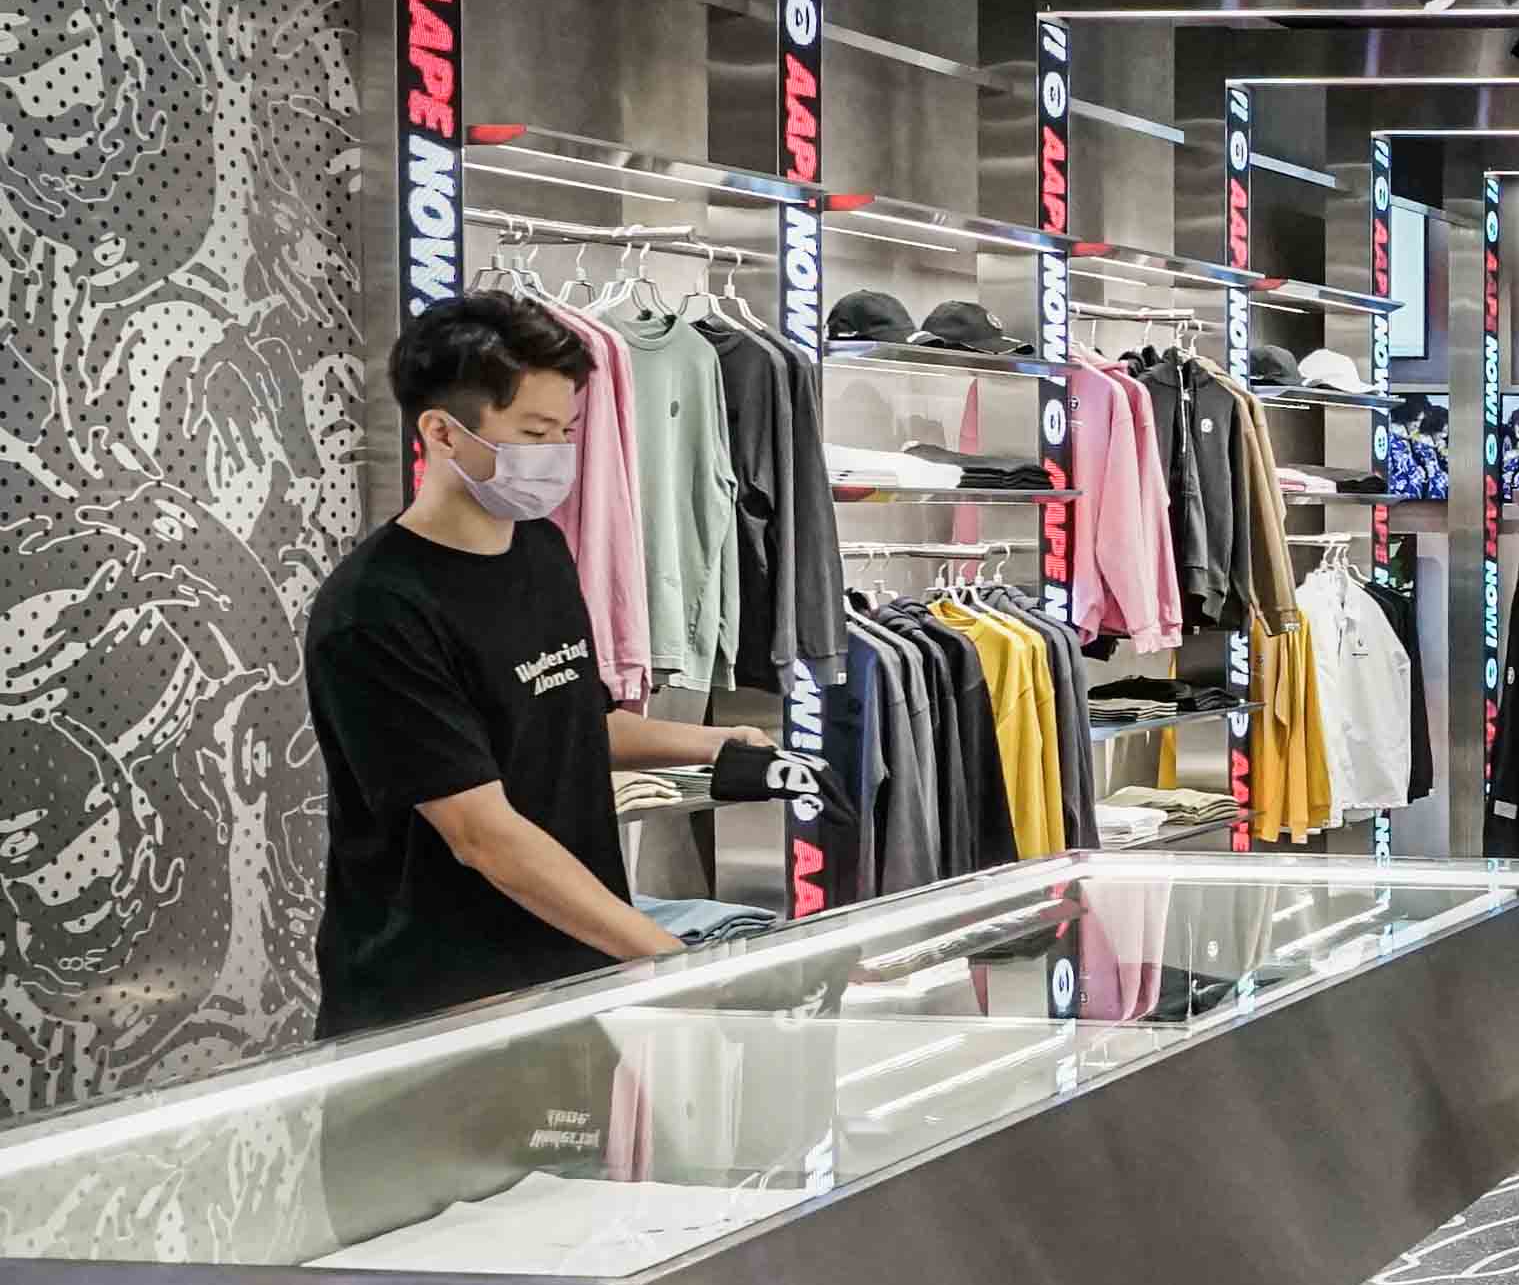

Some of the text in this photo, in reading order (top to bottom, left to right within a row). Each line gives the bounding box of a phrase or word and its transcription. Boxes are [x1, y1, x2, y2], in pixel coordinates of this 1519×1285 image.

[1230, 289, 1249, 393] NOW
[1375, 218, 1389, 400] AAP NOW
[1486, 251, 1498, 426] AAPE NOW!
[1486, 475, 1498, 647] AAPE NOW!
